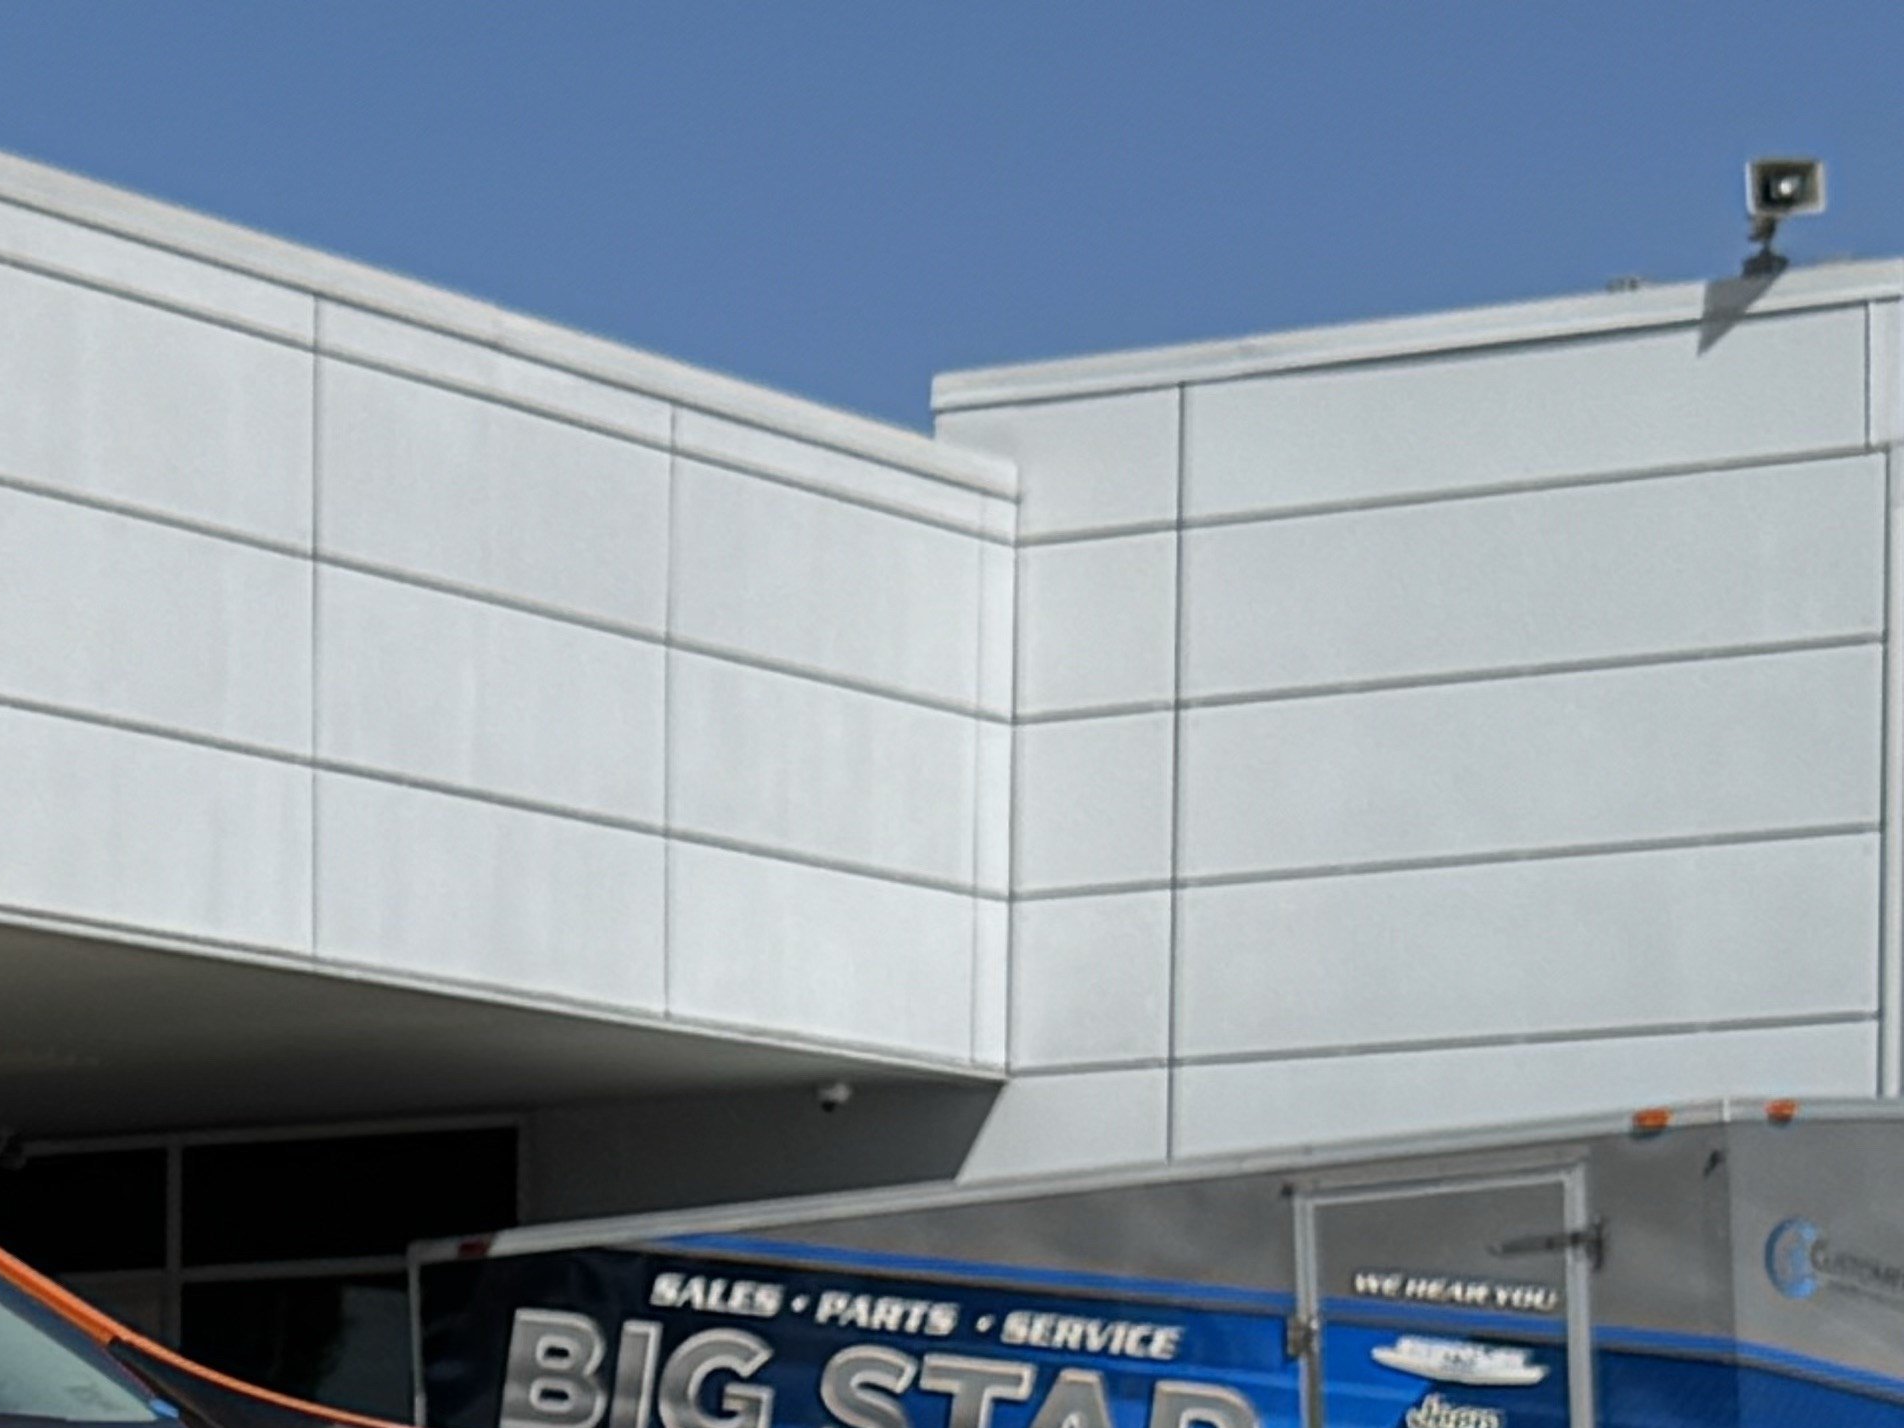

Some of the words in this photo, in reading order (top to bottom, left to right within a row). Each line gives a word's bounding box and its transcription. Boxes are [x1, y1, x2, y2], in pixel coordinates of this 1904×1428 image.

[650, 1272, 778, 1318] SALES
[816, 1290, 959, 1336] PARTS
[1000, 1307, 1184, 1360] SERVICE
